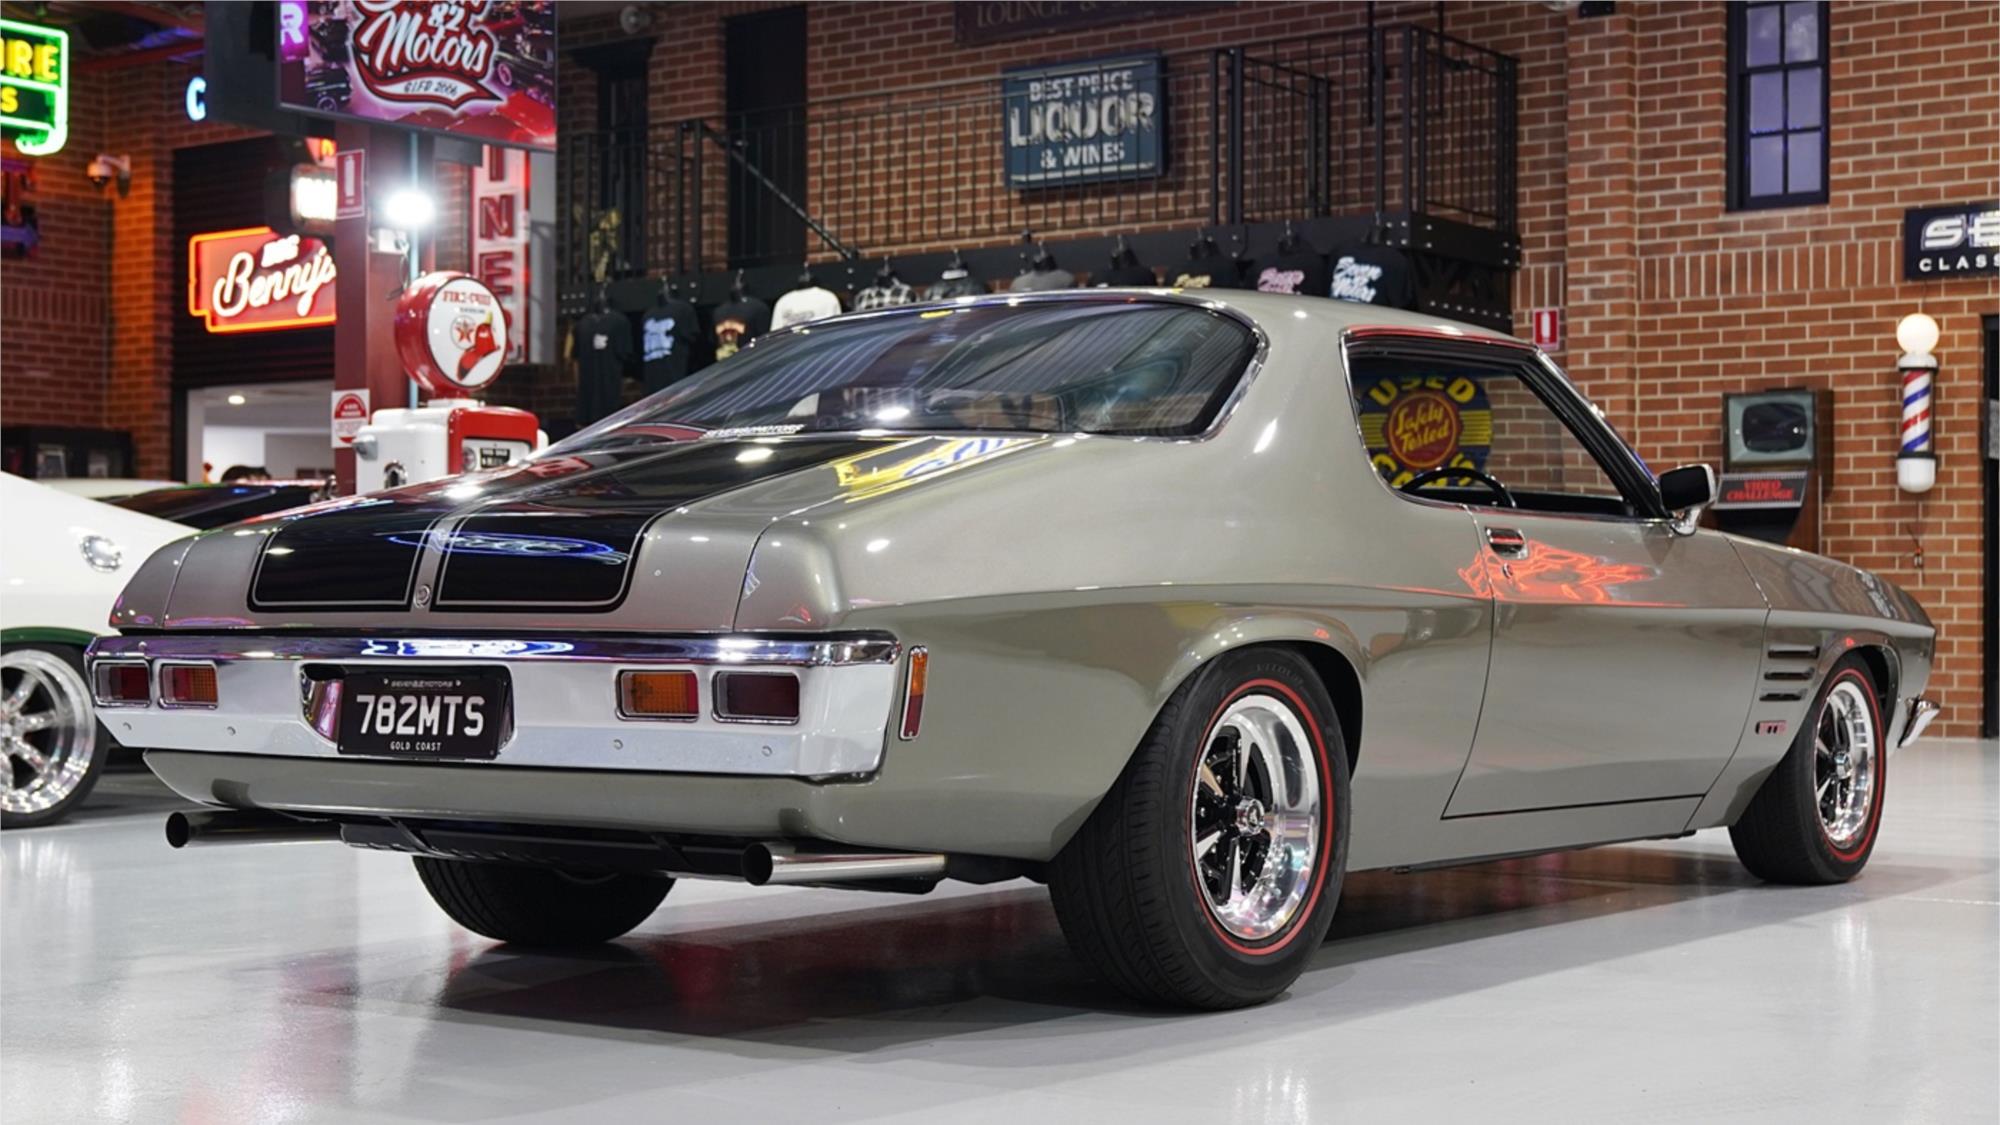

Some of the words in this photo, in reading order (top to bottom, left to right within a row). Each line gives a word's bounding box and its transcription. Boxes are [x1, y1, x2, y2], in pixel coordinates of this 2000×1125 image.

[427, 4, 465, 32] 82
[360, 9, 488, 73] Motors
[1029, 76, 1075, 101] BEST
[1078, 70, 1133, 96] PRICE
[1010, 92, 1155, 147] LIQUOR
[1040, 149, 1057, 168] &
[1062, 142, 1125, 166] WINES
[212, 246, 337, 317] Benny's
[1395, 403, 1446, 436] Safety
[1400, 419, 1450, 454] Tested
[356, 694, 486, 737] 782MTS
[389, 740, 411, 751] GOLD
[415, 741, 442, 752] COAST
